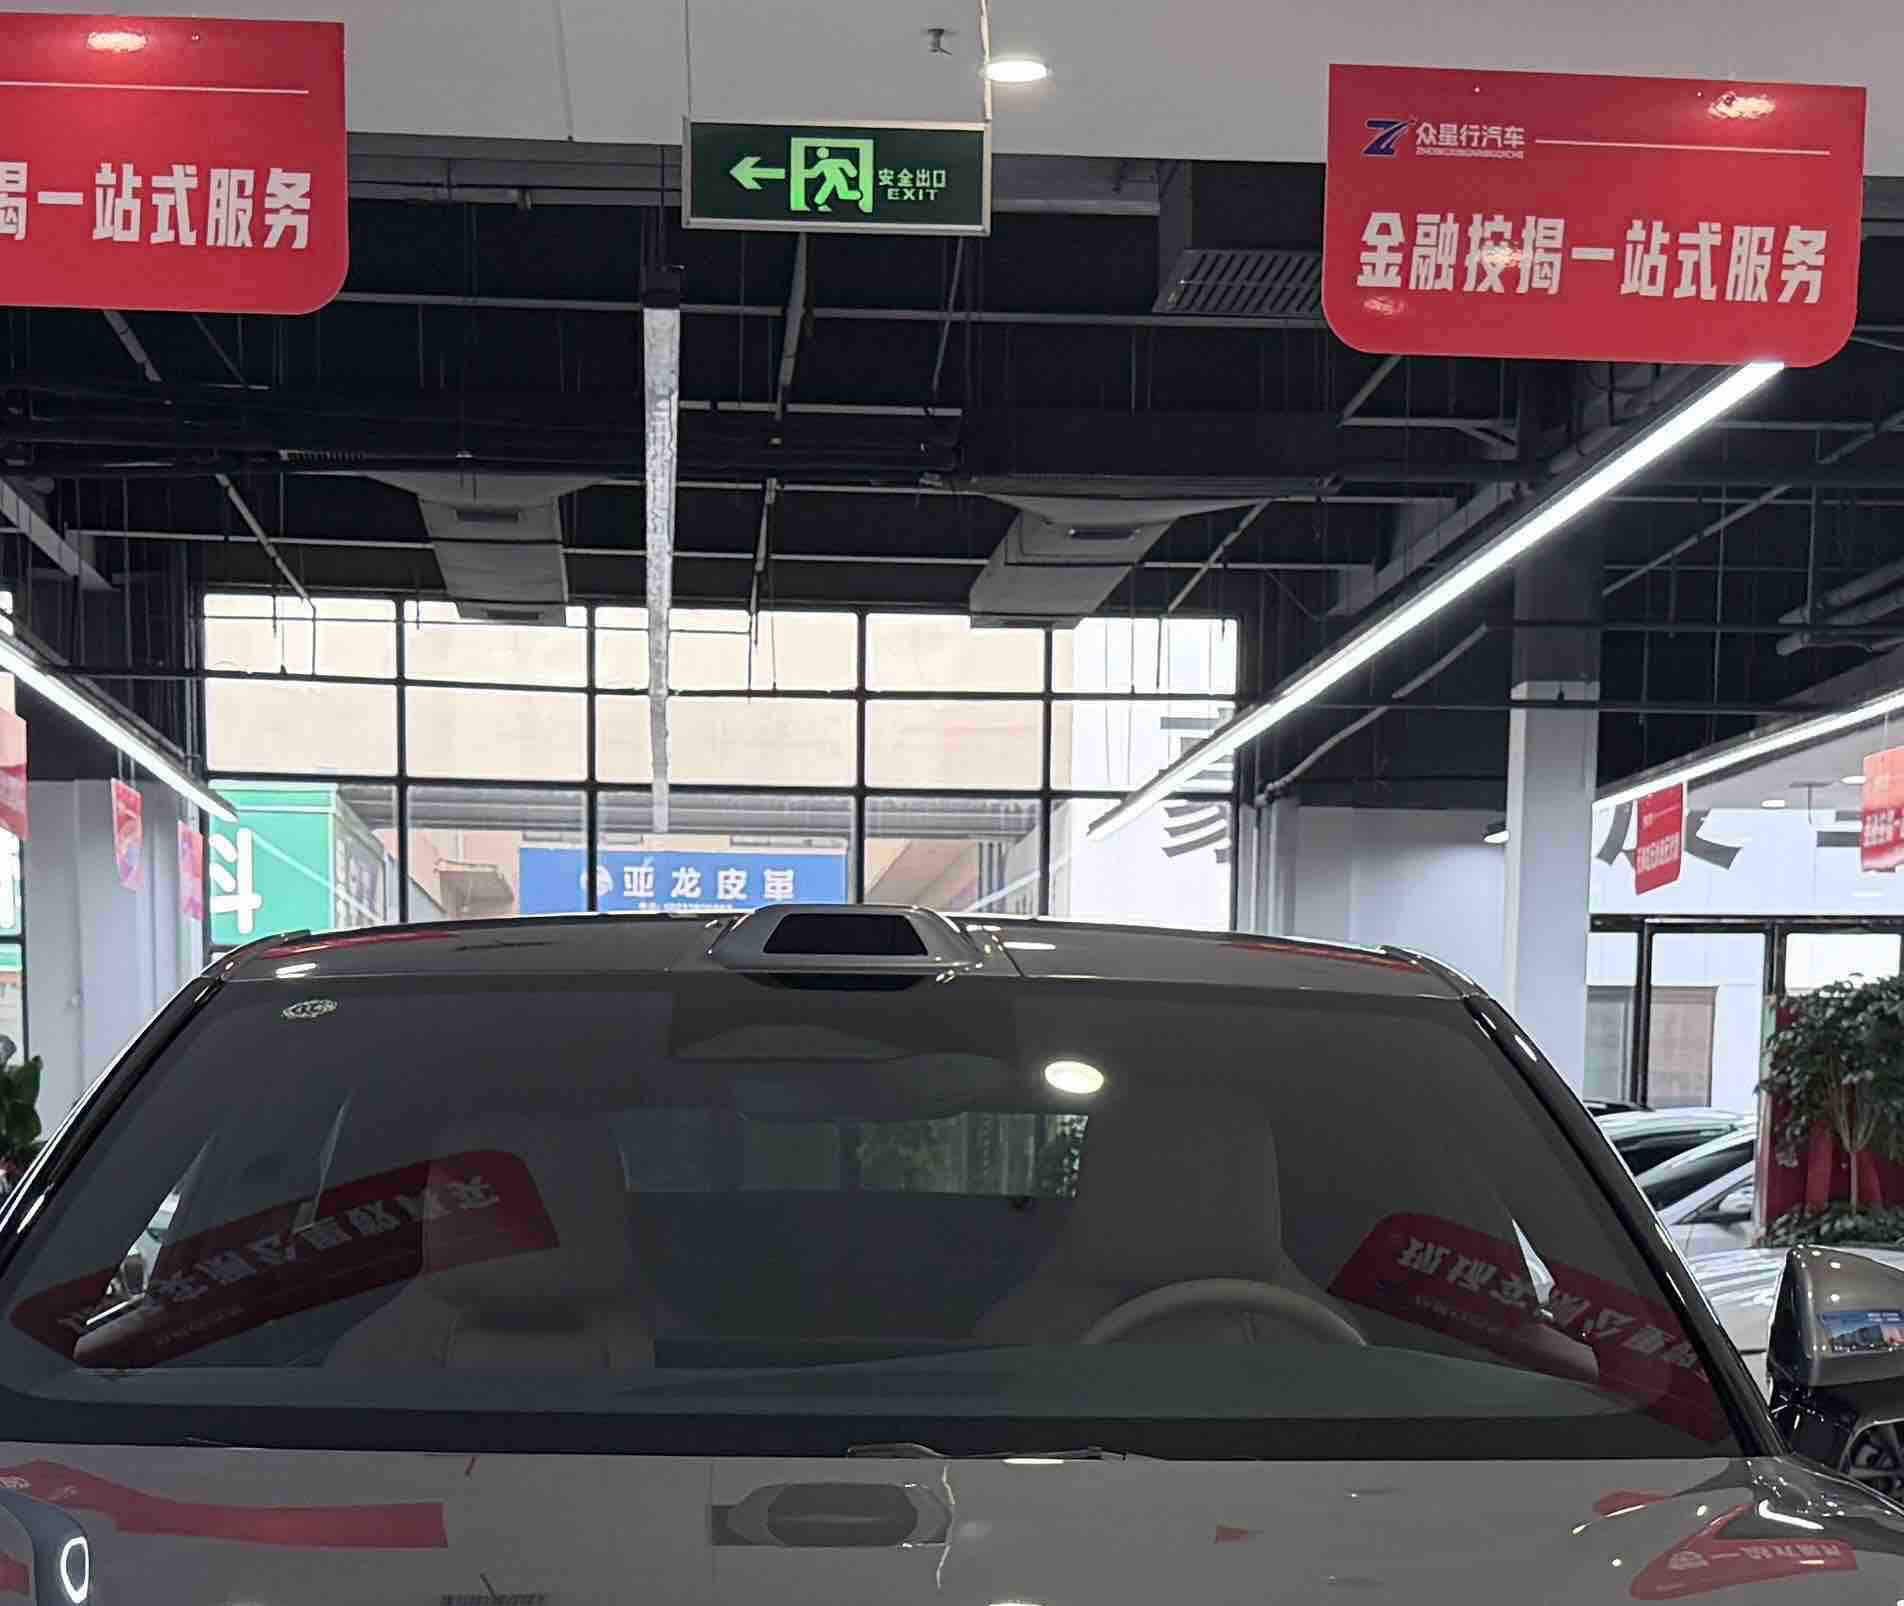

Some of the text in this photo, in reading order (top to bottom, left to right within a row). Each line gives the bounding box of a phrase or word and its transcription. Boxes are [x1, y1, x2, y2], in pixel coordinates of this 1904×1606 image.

[1415, 122, 1525, 148] 众星行汽车
[878, 168, 947, 188] 安全出口
[887, 187, 939, 201] EXIT
[1356, 211, 1828, 304] 金融按揭一站式服务
